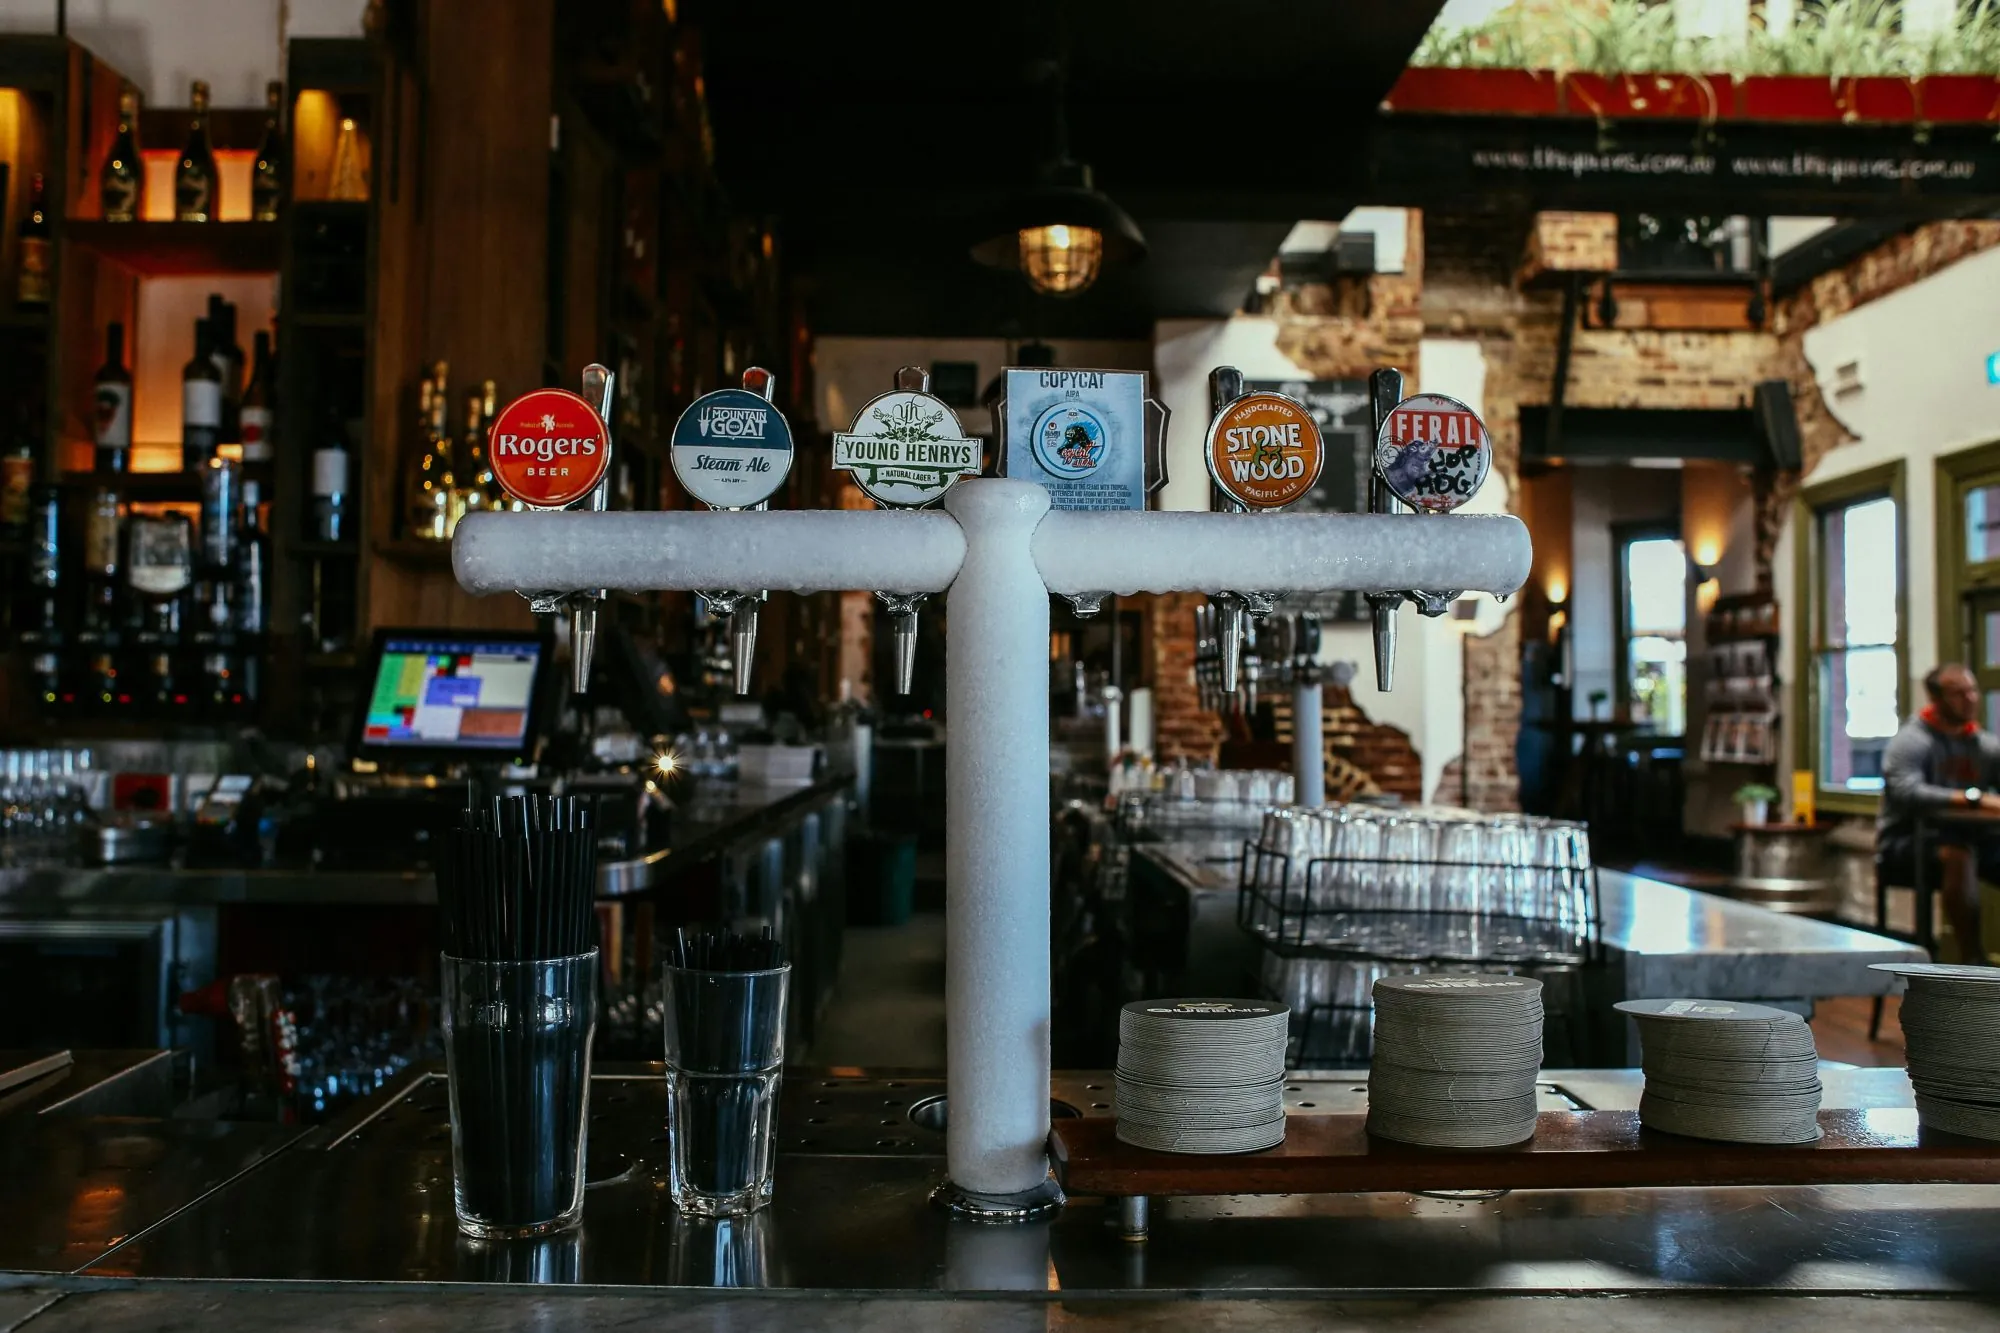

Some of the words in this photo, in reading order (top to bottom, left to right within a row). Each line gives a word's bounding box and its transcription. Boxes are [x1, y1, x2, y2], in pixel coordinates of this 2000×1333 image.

[1039, 371, 1106, 389] COPYCAT
[712, 409, 767, 421] MOUNTAIN
[1233, 403, 1293, 422] HANDCRAFTED
[710, 418, 767, 436] GOAT
[1396, 413, 1476, 445] FERAL
[1225, 423, 1303, 453] STONE
[844, 441, 900, 461] YOUNG
[905, 444, 971, 464] HENRYS
[1428, 444, 1478, 474] HOP
[527, 467, 569, 476] BEER
[691, 454, 744, 472] Steam
[745, 456, 771, 473] Ale
[1228, 455, 1305, 483] WOOD
[885, 470, 912, 480] NATURAL
[912, 472, 932, 482] LAGER
[1245, 485, 1279, 498] PACIFIC
[1282, 481, 1297, 495] ALE
